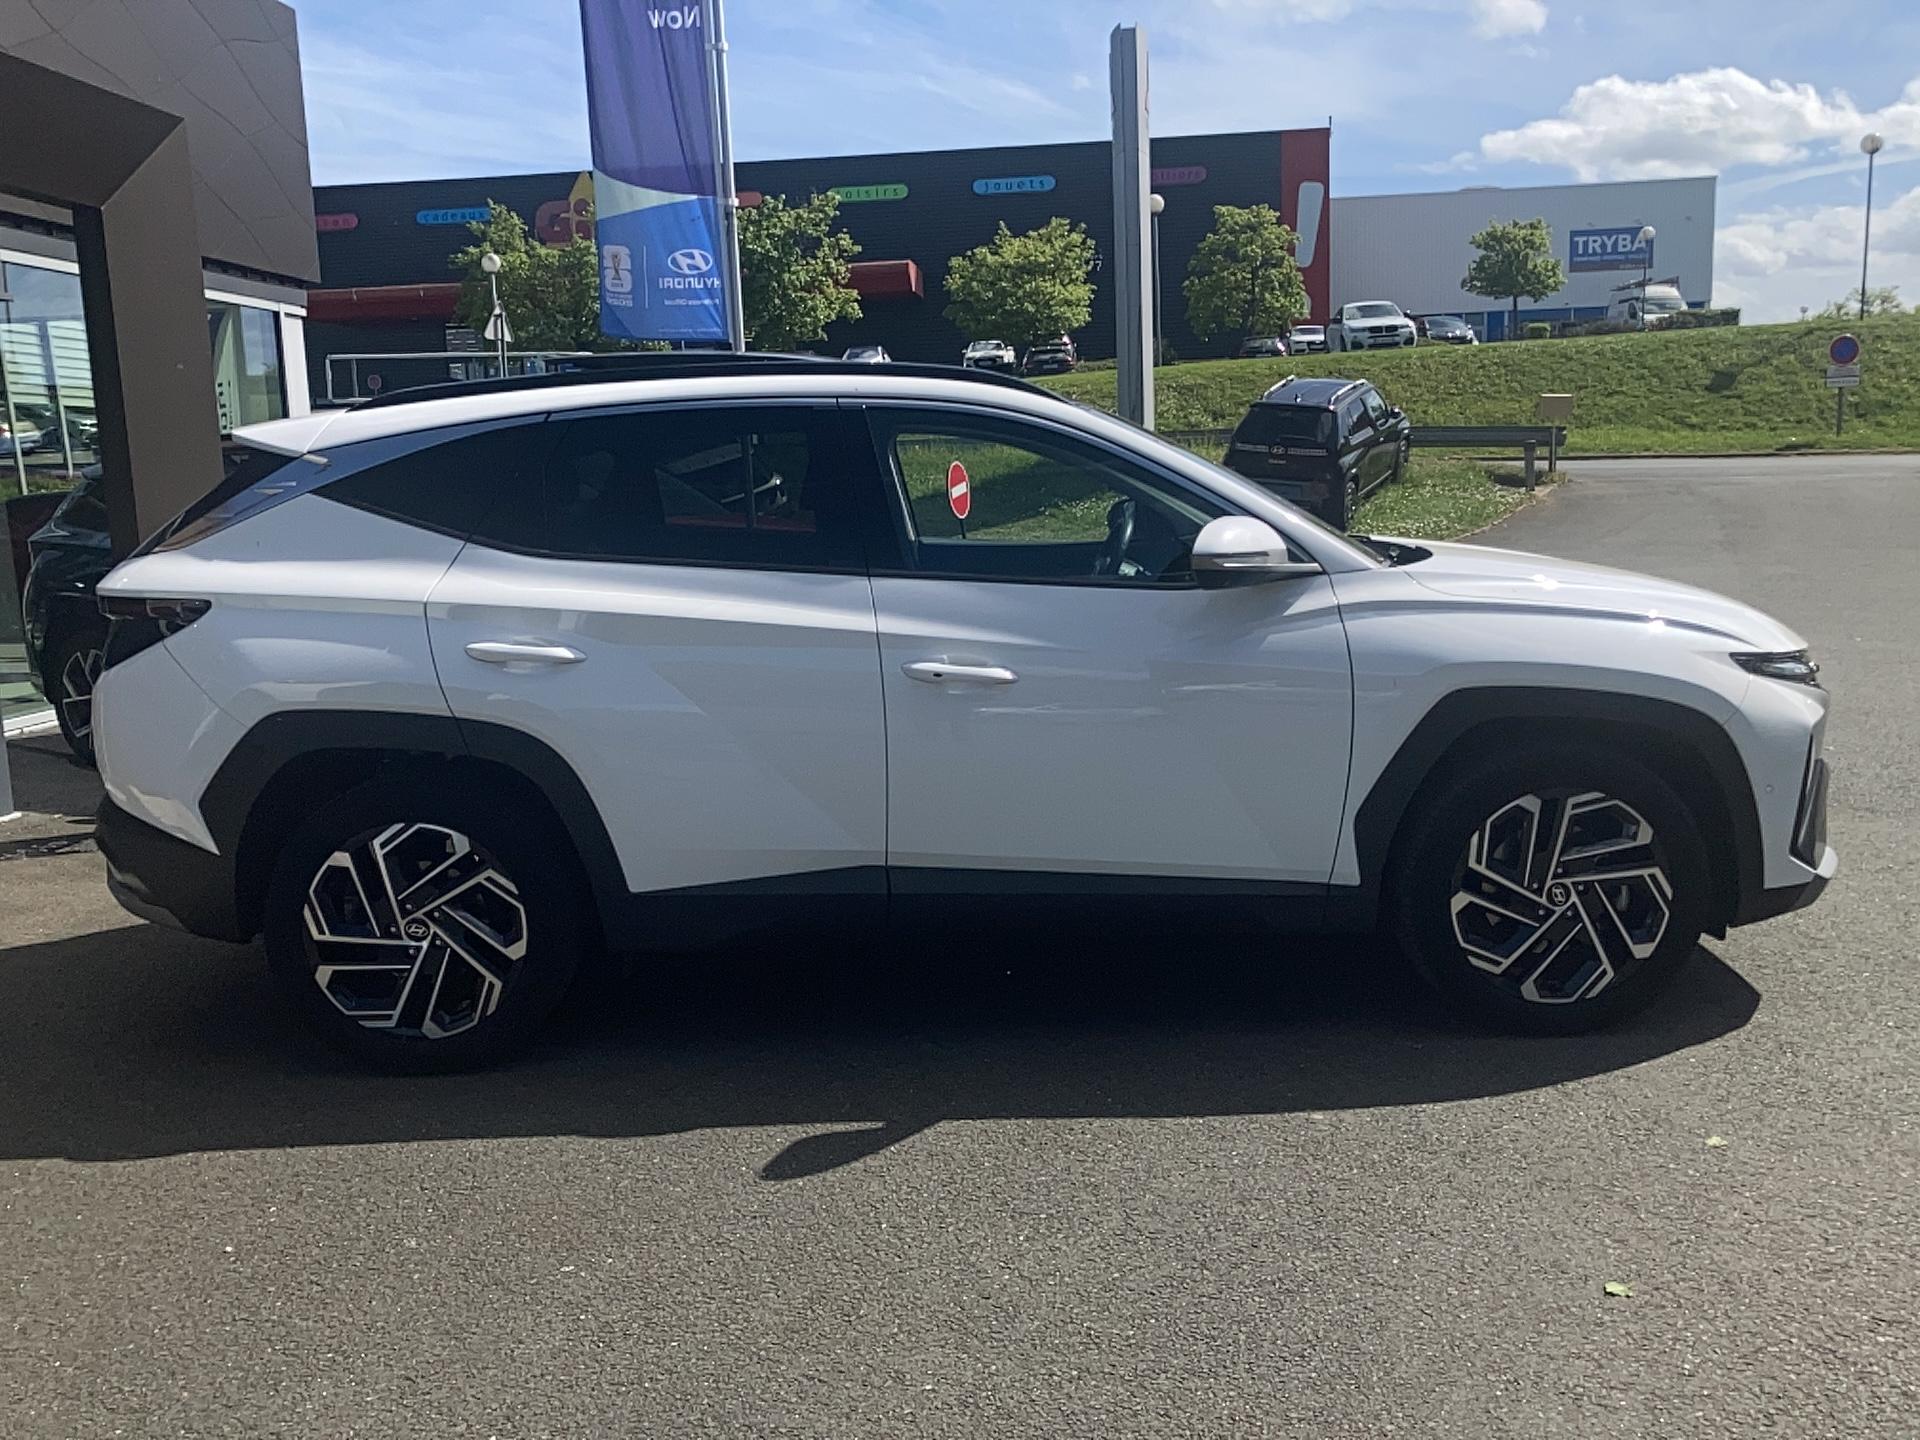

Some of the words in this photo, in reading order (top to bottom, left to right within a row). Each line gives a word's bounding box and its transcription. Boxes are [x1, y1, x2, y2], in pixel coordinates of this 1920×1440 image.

[984, 179, 1046, 193] jouets
[423, 211, 485, 223] cadeaux
[1573, 232, 1646, 255] TRYBA
